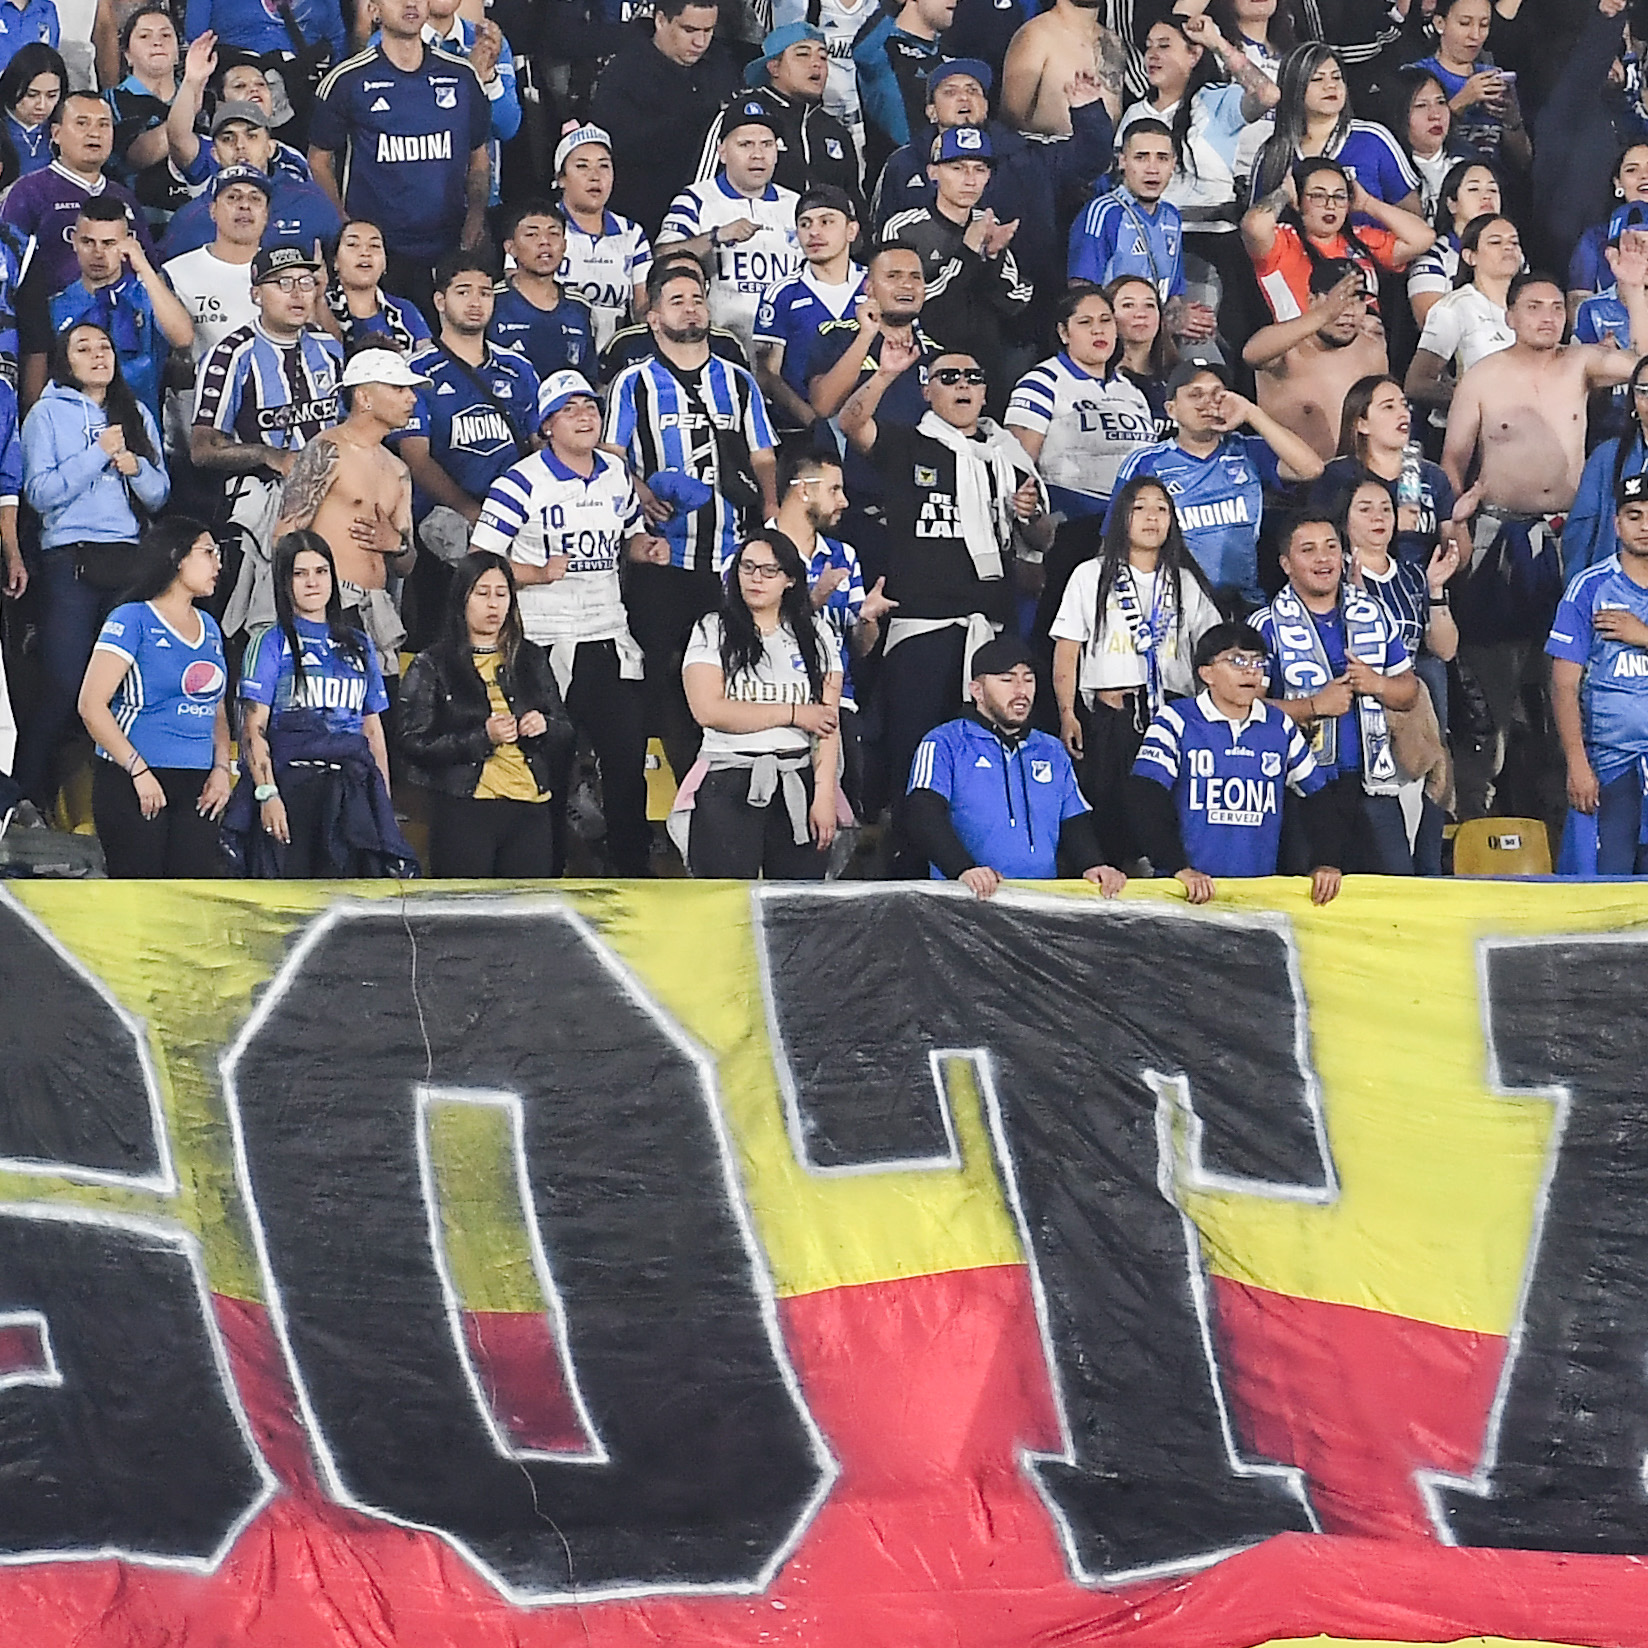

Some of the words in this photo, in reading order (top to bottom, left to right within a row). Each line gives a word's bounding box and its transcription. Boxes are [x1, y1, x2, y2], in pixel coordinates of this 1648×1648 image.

[377, 132, 451, 163] ANDINA
[193, 295, 221, 313] 76
[451, 413, 511, 443] ANDINA
[541, 504, 566, 530] 10
[1187, 749, 1214, 777] 10
[1189, 776, 1277, 815] LEONA
[1208, 810, 1263, 825] CERVEZA
